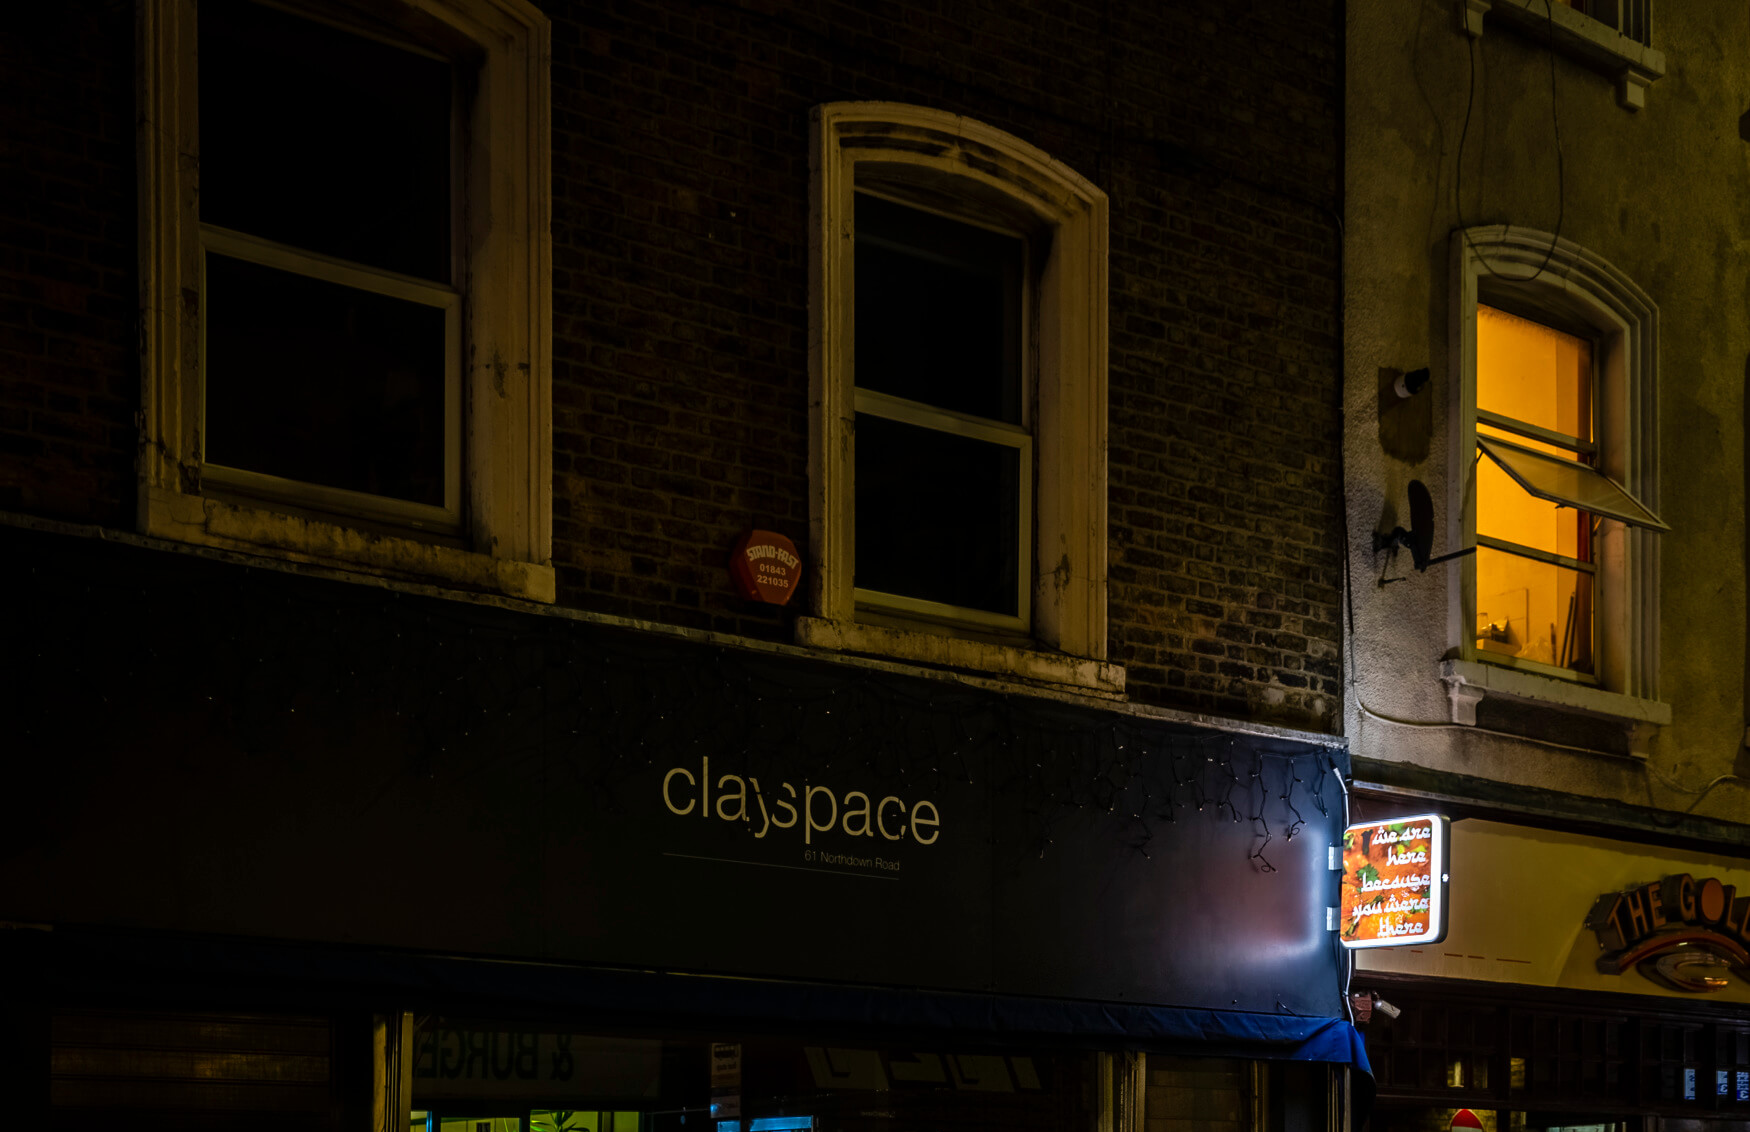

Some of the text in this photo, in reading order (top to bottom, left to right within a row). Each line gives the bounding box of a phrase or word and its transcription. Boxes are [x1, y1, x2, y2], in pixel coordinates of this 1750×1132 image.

[759, 563, 786, 576] 01843
[757, 574, 789, 589] 221035
[662, 755, 940, 845] clayspace
[804, 849, 900, 871] 61 Northdown Road
[1386, 846, 1427, 867] here
[1361, 872, 1431, 893] because
[1352, 901, 1382, 924] you
[1604, 882, 1667, 950] THE
[1377, 916, 1424, 938] there
